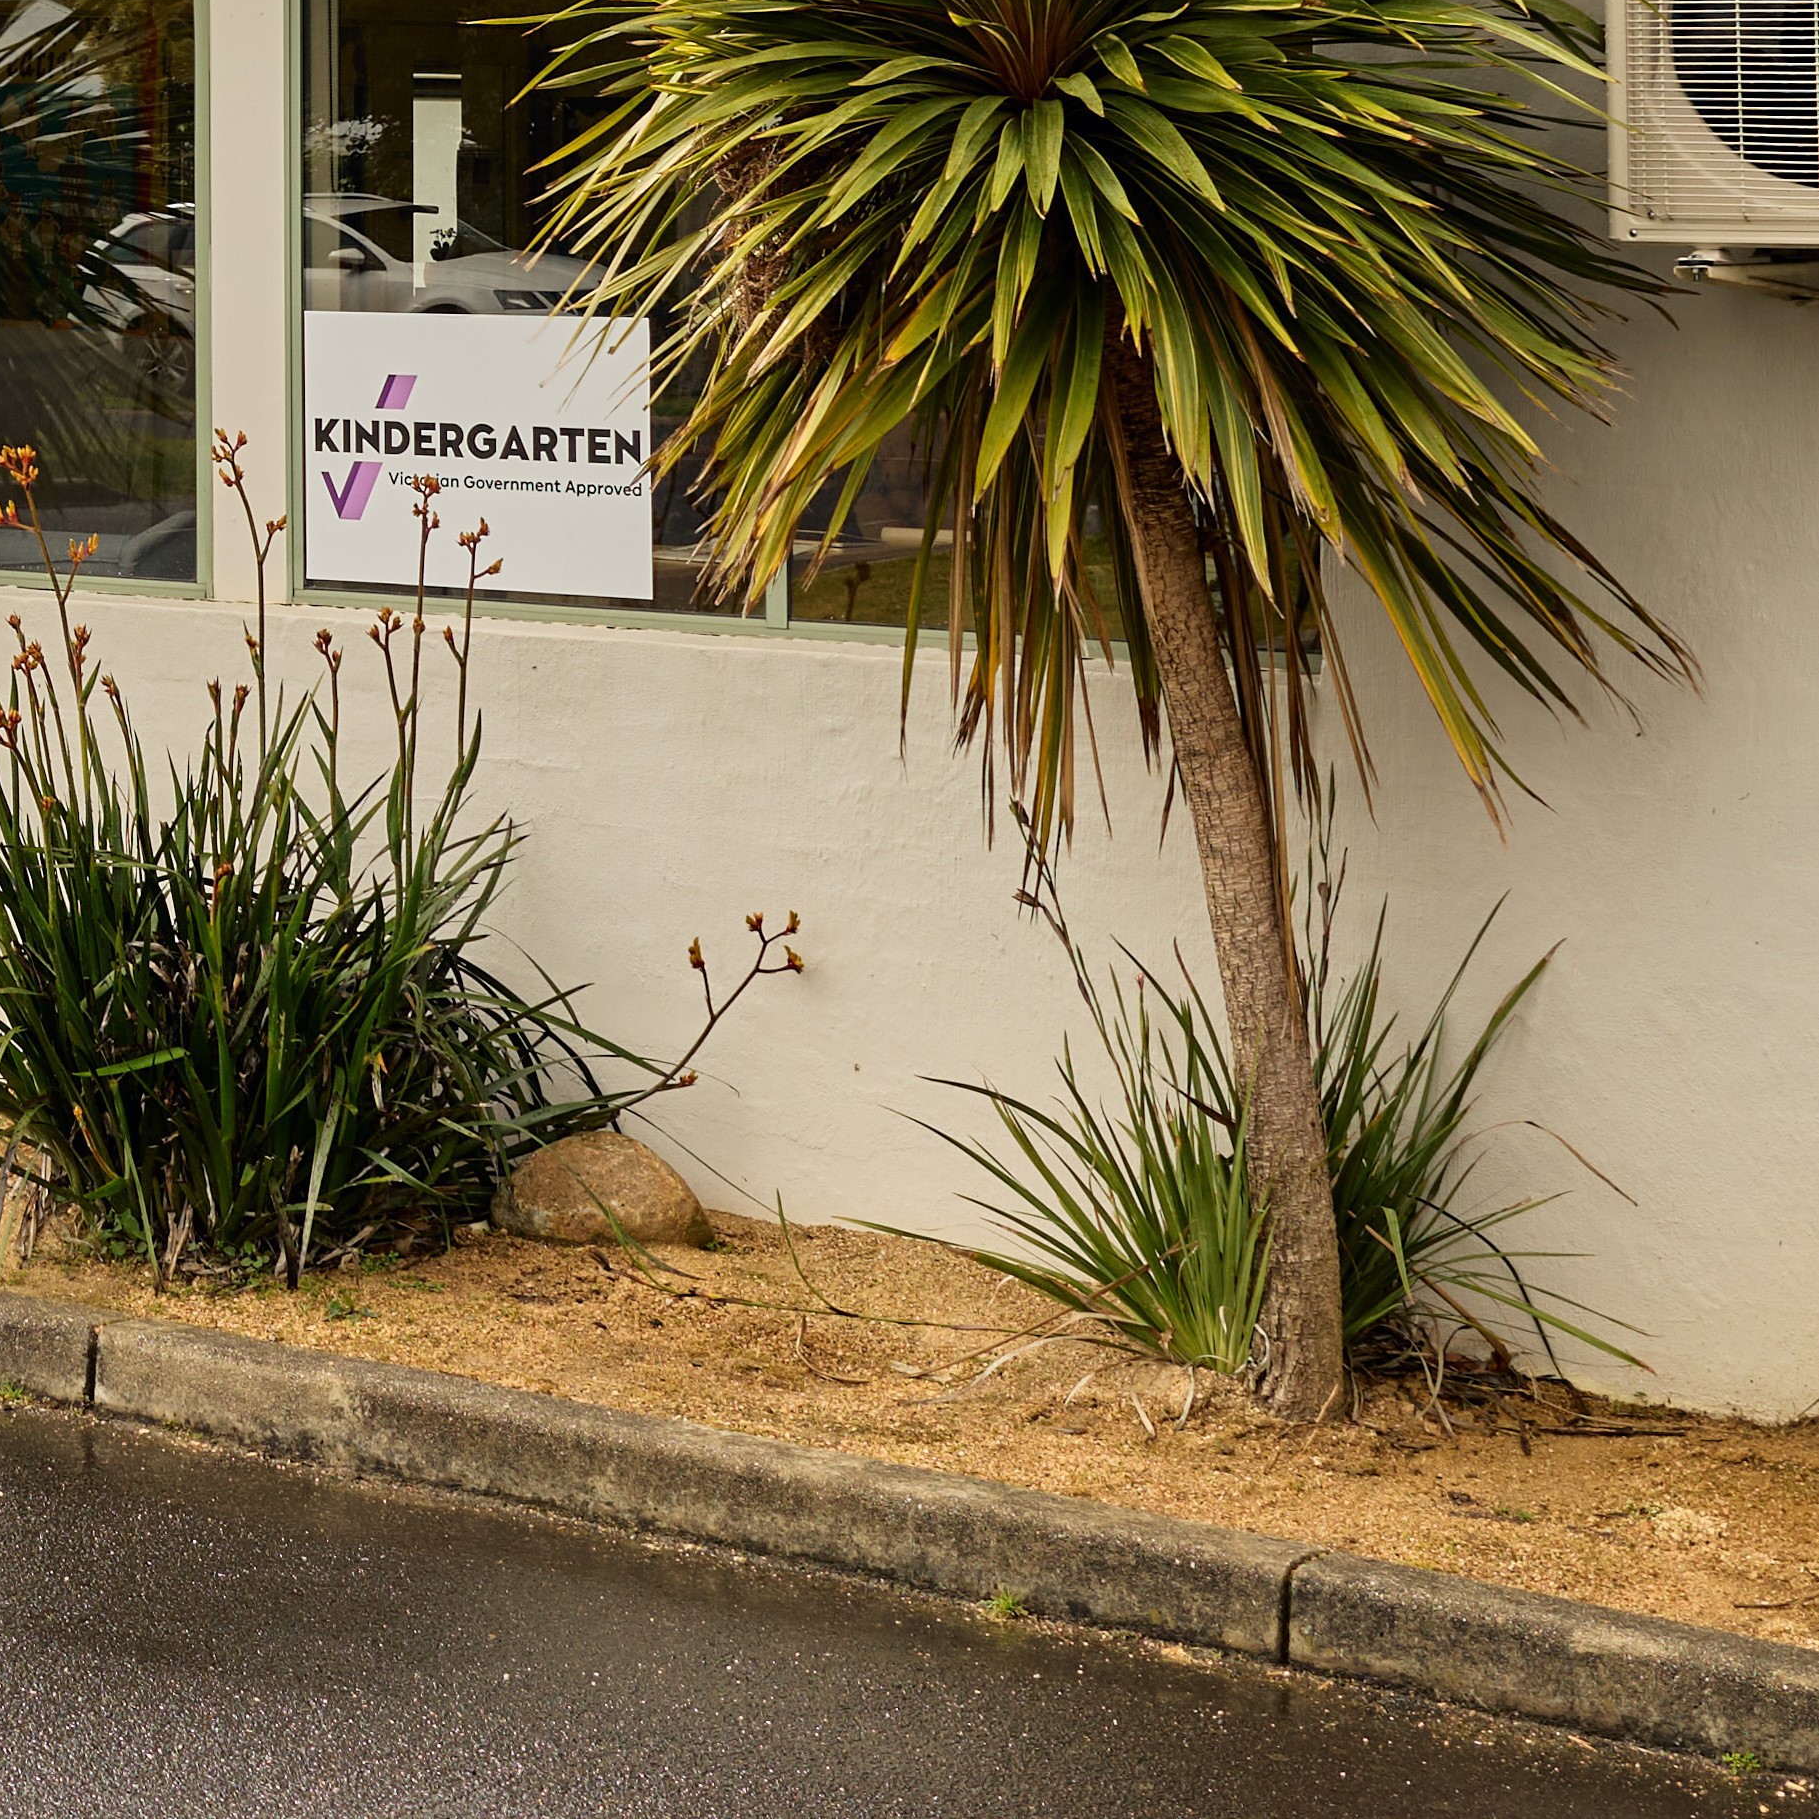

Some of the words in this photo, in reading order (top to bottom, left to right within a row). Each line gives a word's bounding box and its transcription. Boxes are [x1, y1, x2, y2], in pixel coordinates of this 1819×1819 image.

[314, 418, 642, 465] KINDERGARTEN
[388, 472, 459, 488] Vicoian
[464, 475, 561, 493] Government
[565, 479, 642, 497] Approved
